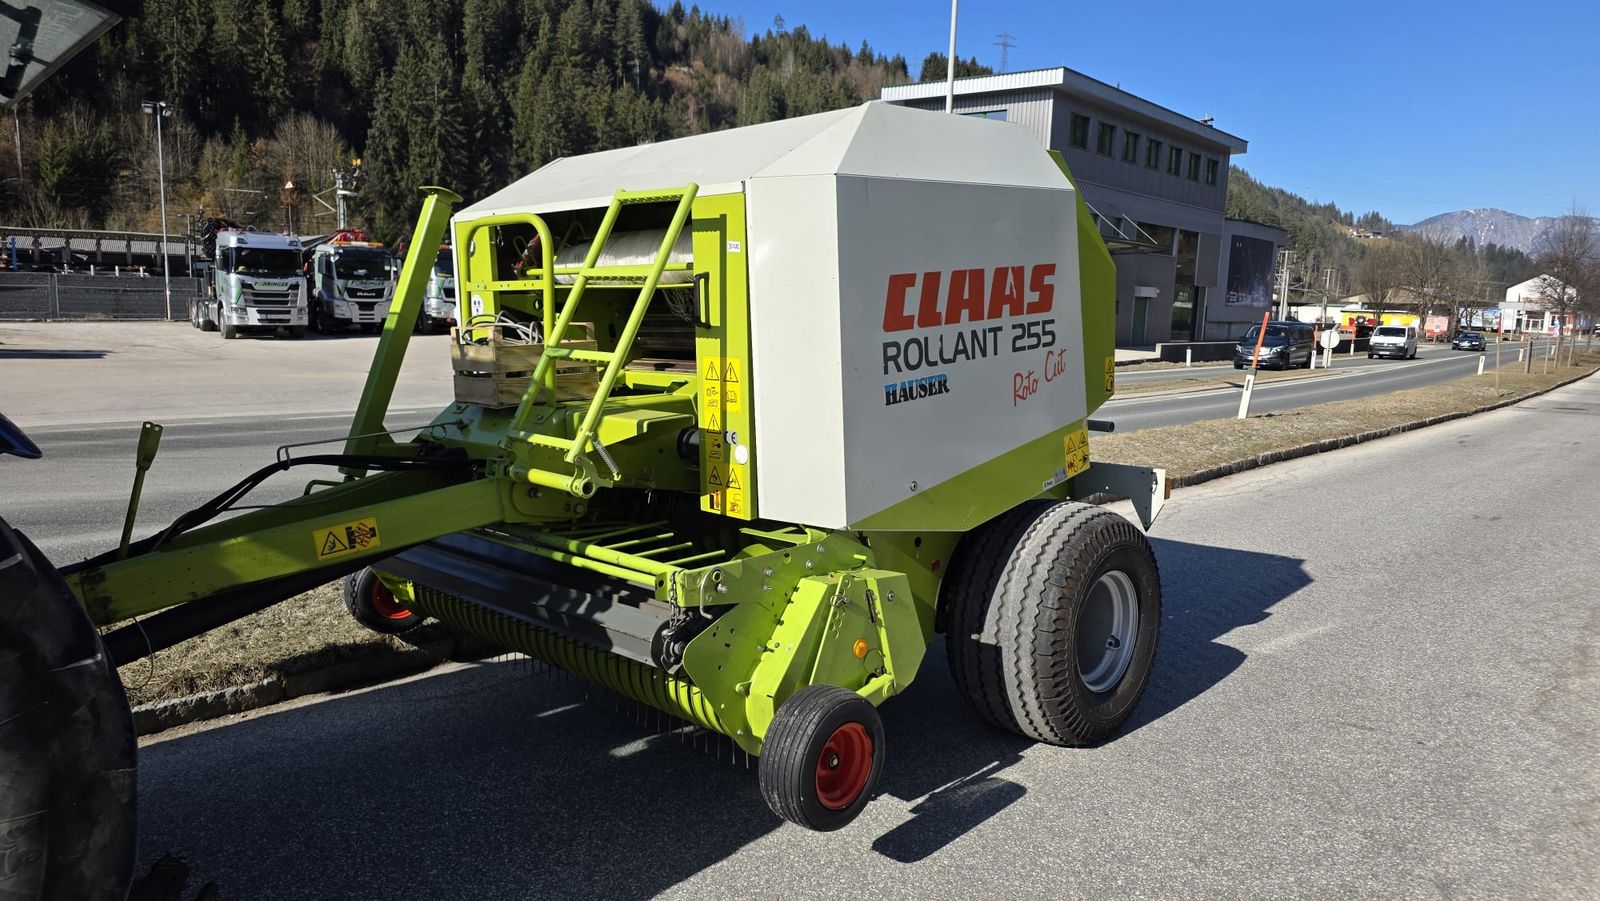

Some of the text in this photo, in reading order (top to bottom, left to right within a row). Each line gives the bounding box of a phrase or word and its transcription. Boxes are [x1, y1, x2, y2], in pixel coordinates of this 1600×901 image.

[882, 263, 1056, 333] CLAAS
[882, 319, 1056, 375] ROLLANT 255
[884, 373, 950, 407] HAUSER
[1013, 348, 1067, 407] Roto Cut
